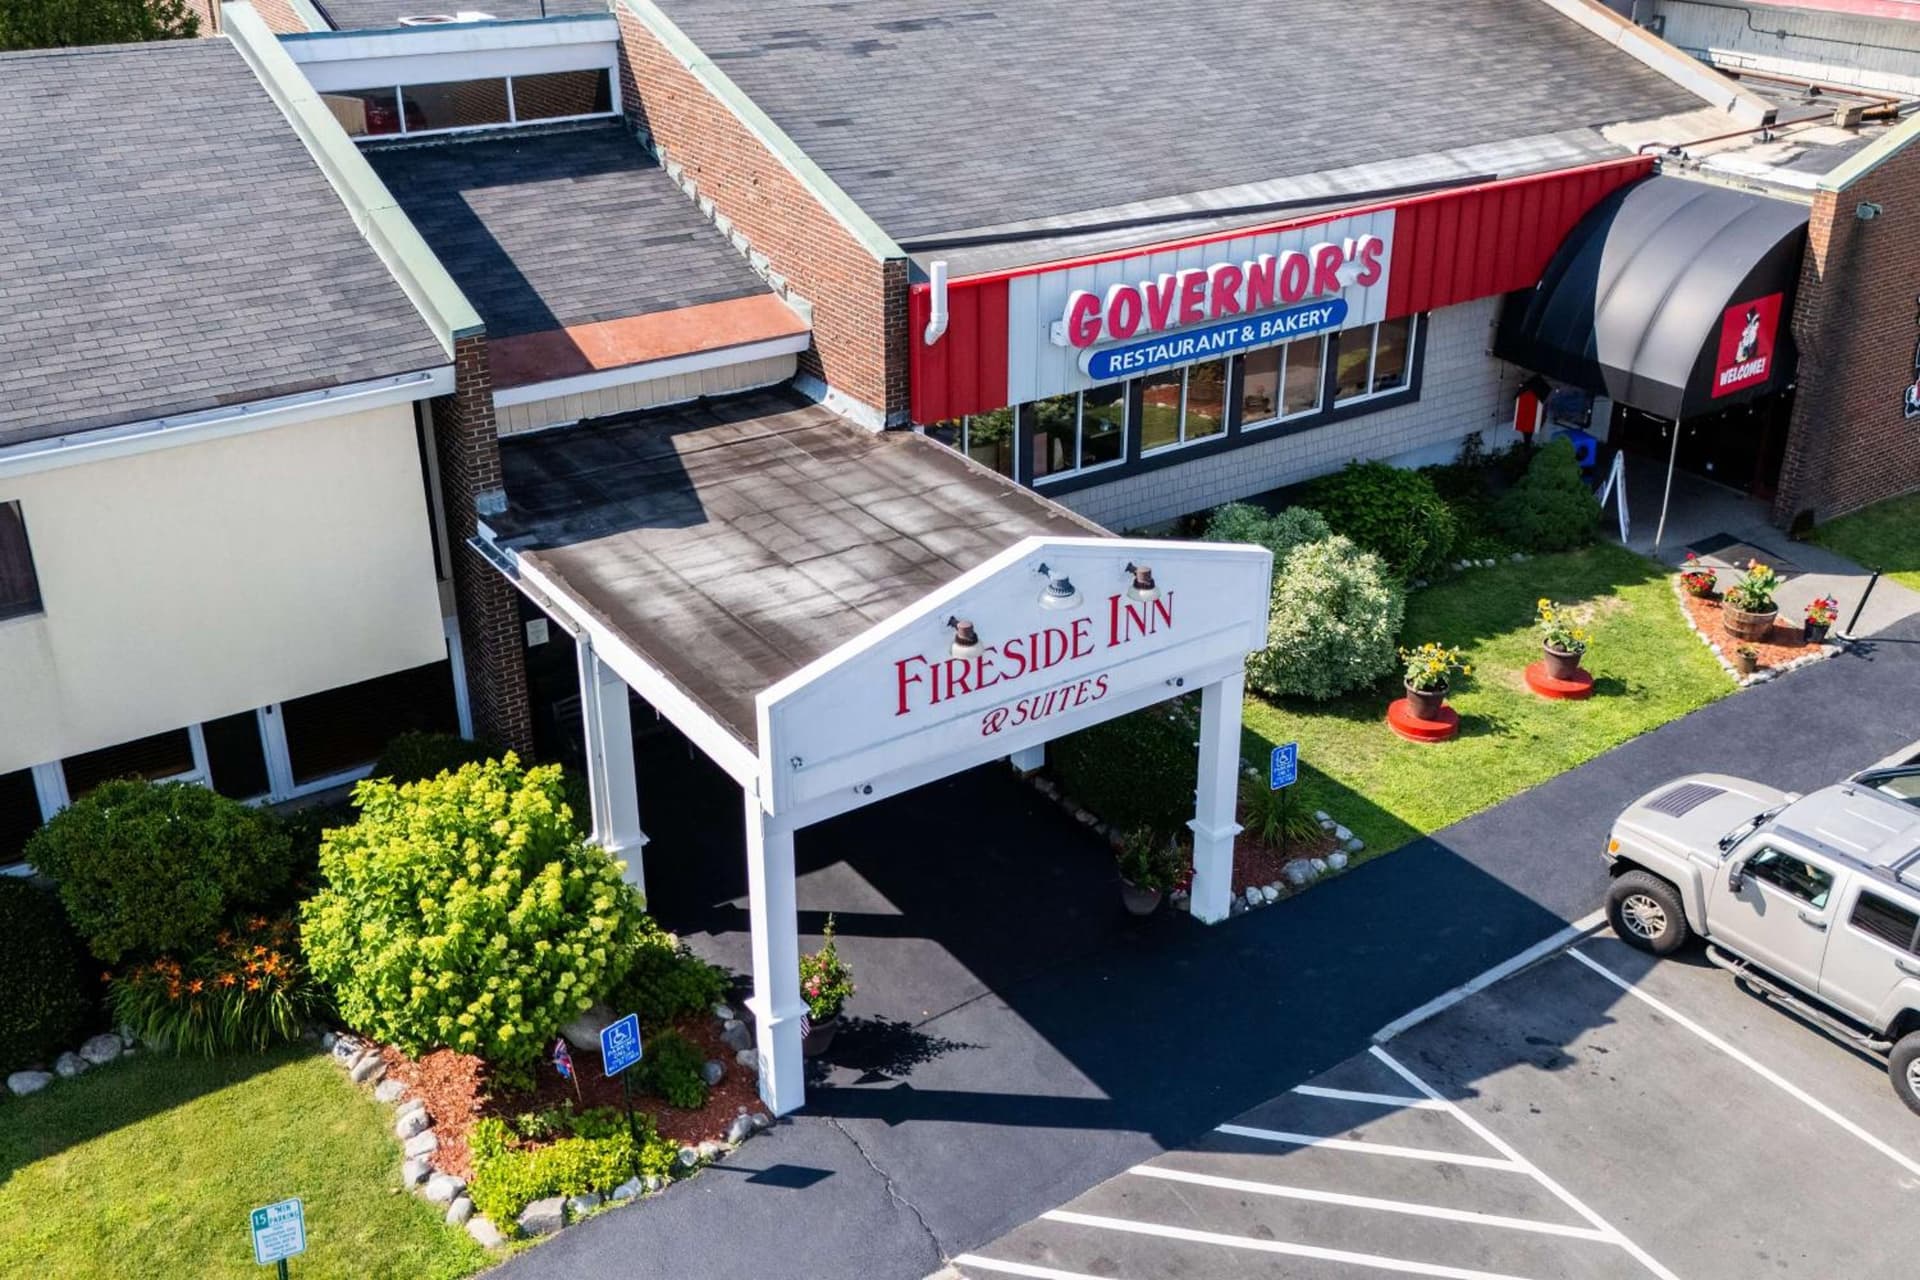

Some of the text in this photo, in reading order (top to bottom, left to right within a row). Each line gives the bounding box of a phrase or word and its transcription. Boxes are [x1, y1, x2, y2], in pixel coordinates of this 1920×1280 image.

[1068, 235, 1384, 348] GOVERNOR'S
[1109, 307, 1334, 373] RESTAURANT & BAKERY
[894, 591, 1174, 716] FIRESIDE INN
[1011, 674, 1109, 726] SUITES
[255, 1213, 267, 1226] 15
